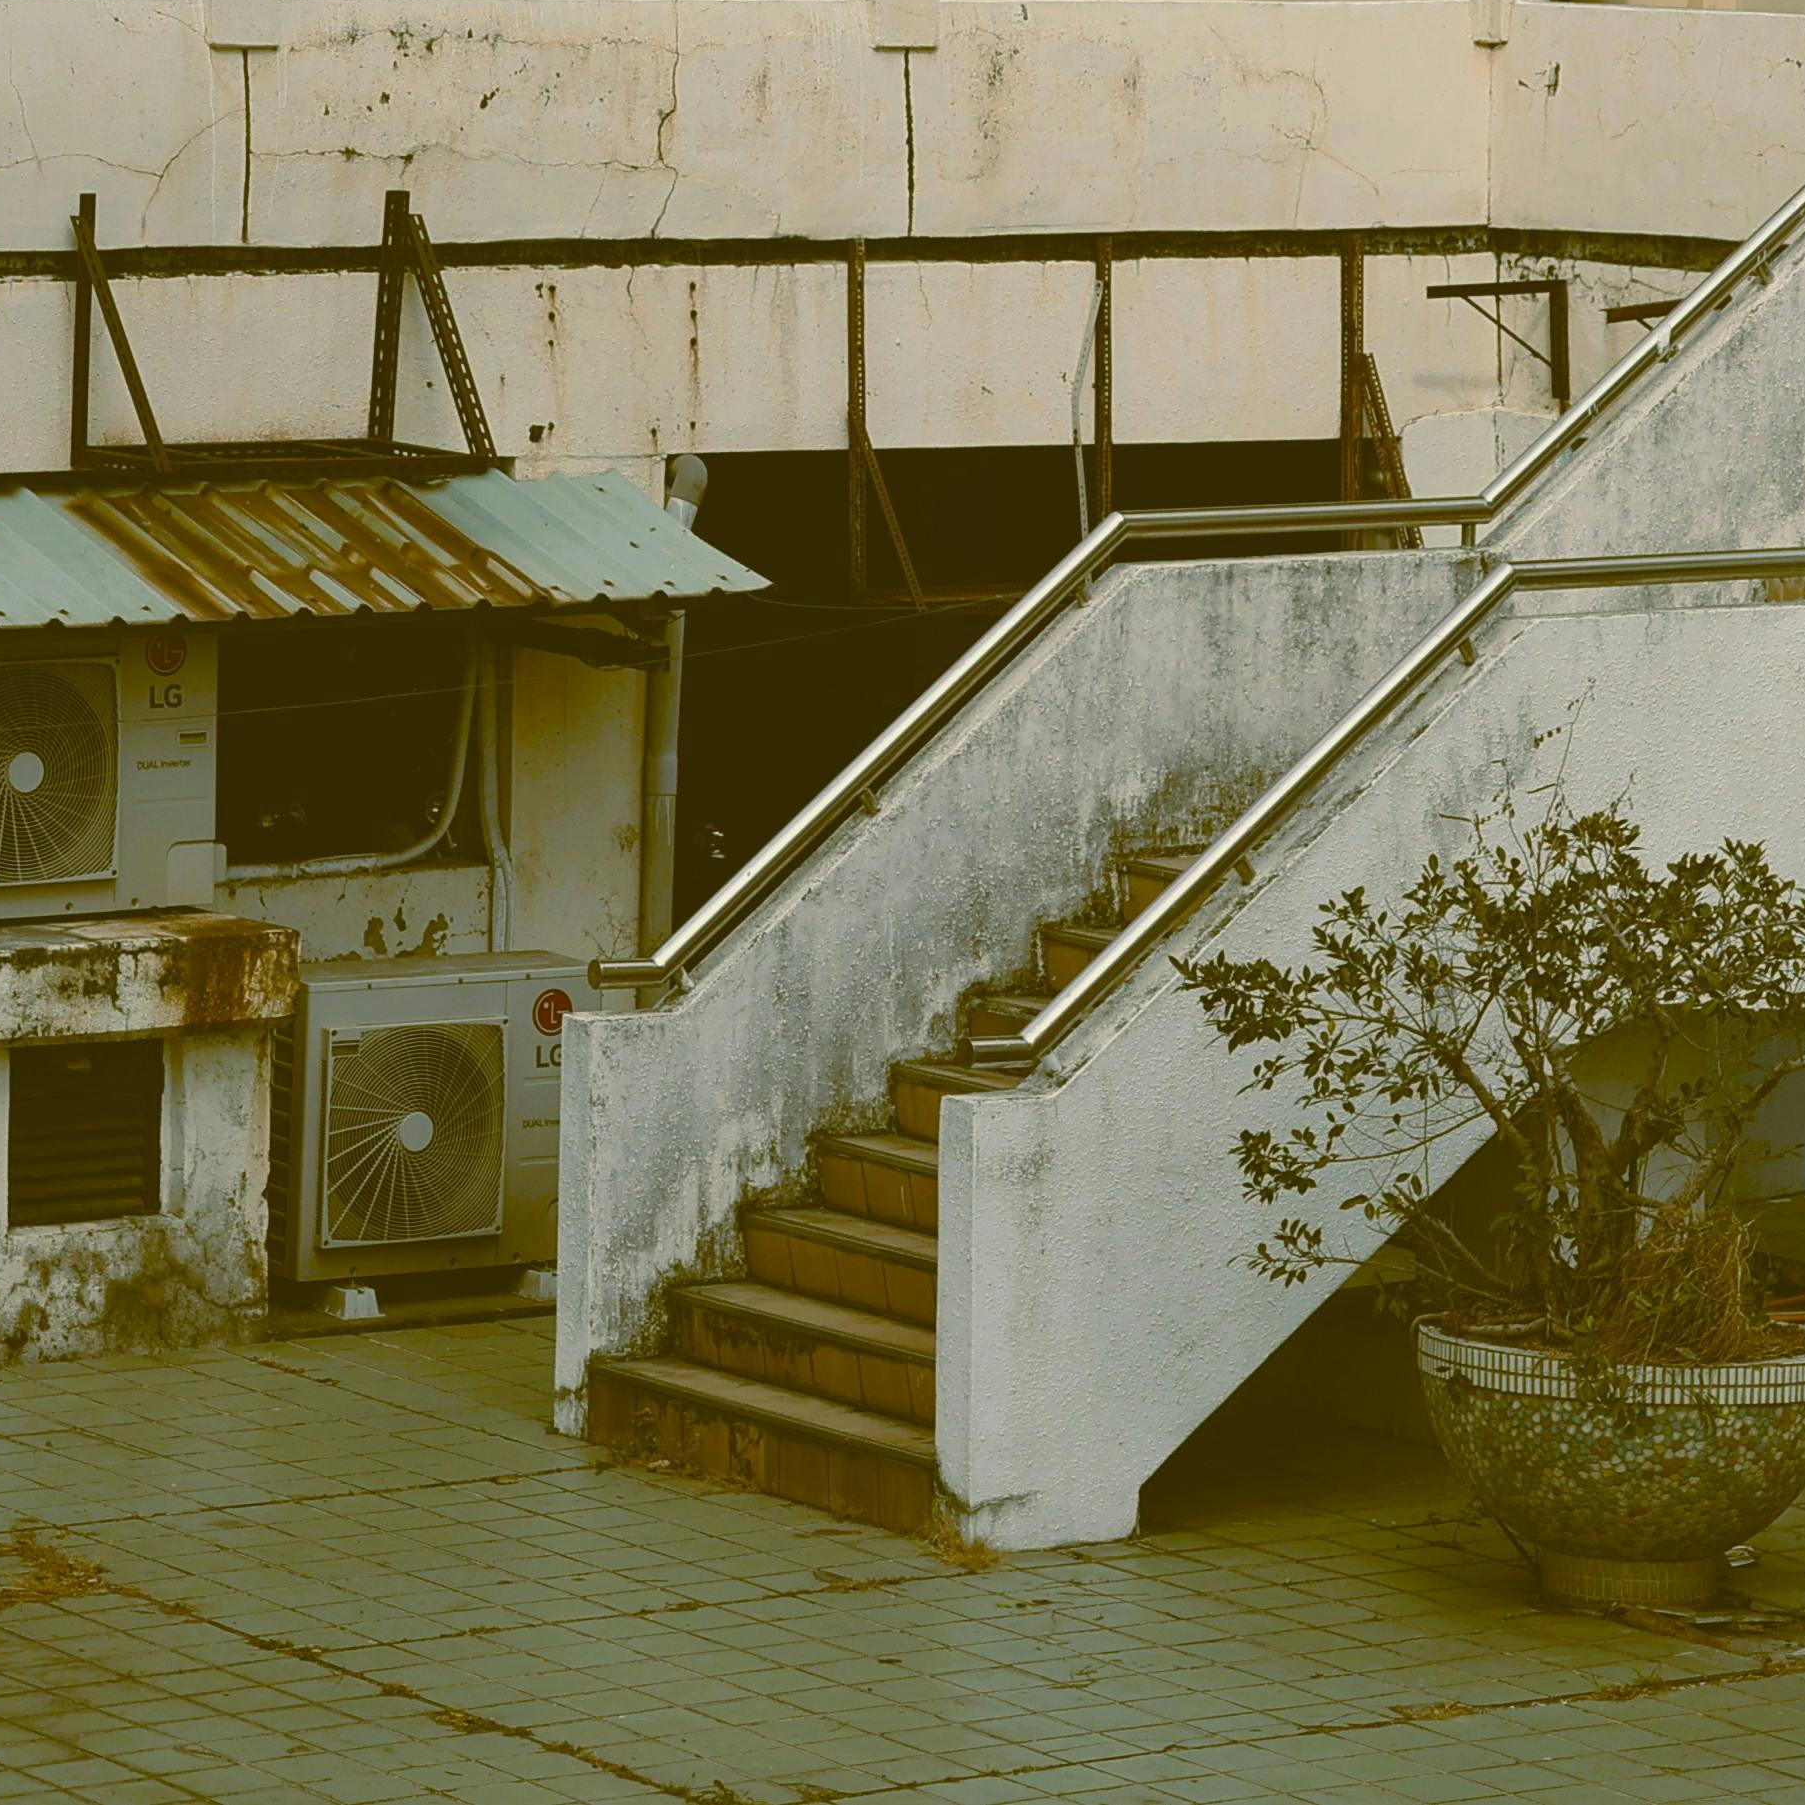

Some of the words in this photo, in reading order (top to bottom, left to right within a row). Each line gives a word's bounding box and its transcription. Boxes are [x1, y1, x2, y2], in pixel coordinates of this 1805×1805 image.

[148, 683, 183, 710] LG
[136, 760, 159, 771] DUAL
[160, 758, 192, 769] Inverter
